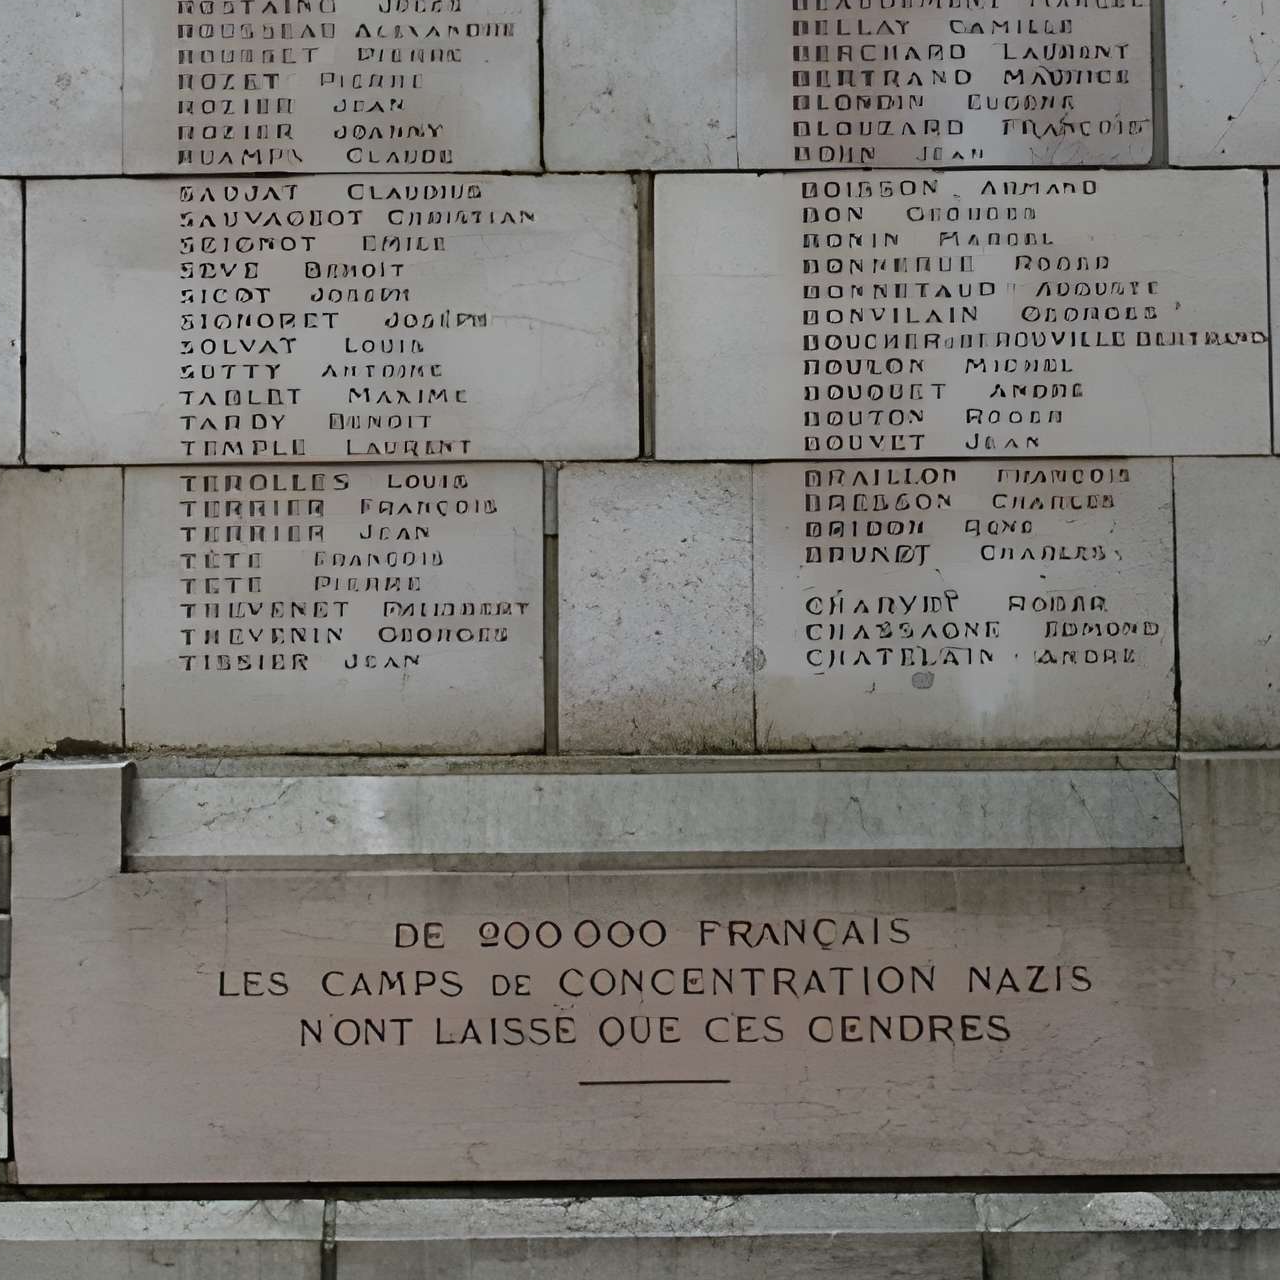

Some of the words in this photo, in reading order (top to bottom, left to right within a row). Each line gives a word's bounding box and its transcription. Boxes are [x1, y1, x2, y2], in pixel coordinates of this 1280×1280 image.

[394, 922, 445, 949] DE
[700, 918, 911, 951] FRANÇAIS
[218, 970, 290, 997] LES
[321, 969, 464, 997] CAMPS
[492, 975, 532, 997] DE
[558, 965, 936, 998] CONCENTRATION
[968, 965, 1093, 996] NAZIS
[705, 1015, 784, 1043] CES
[808, 1014, 1011, 1043] CENDRES
